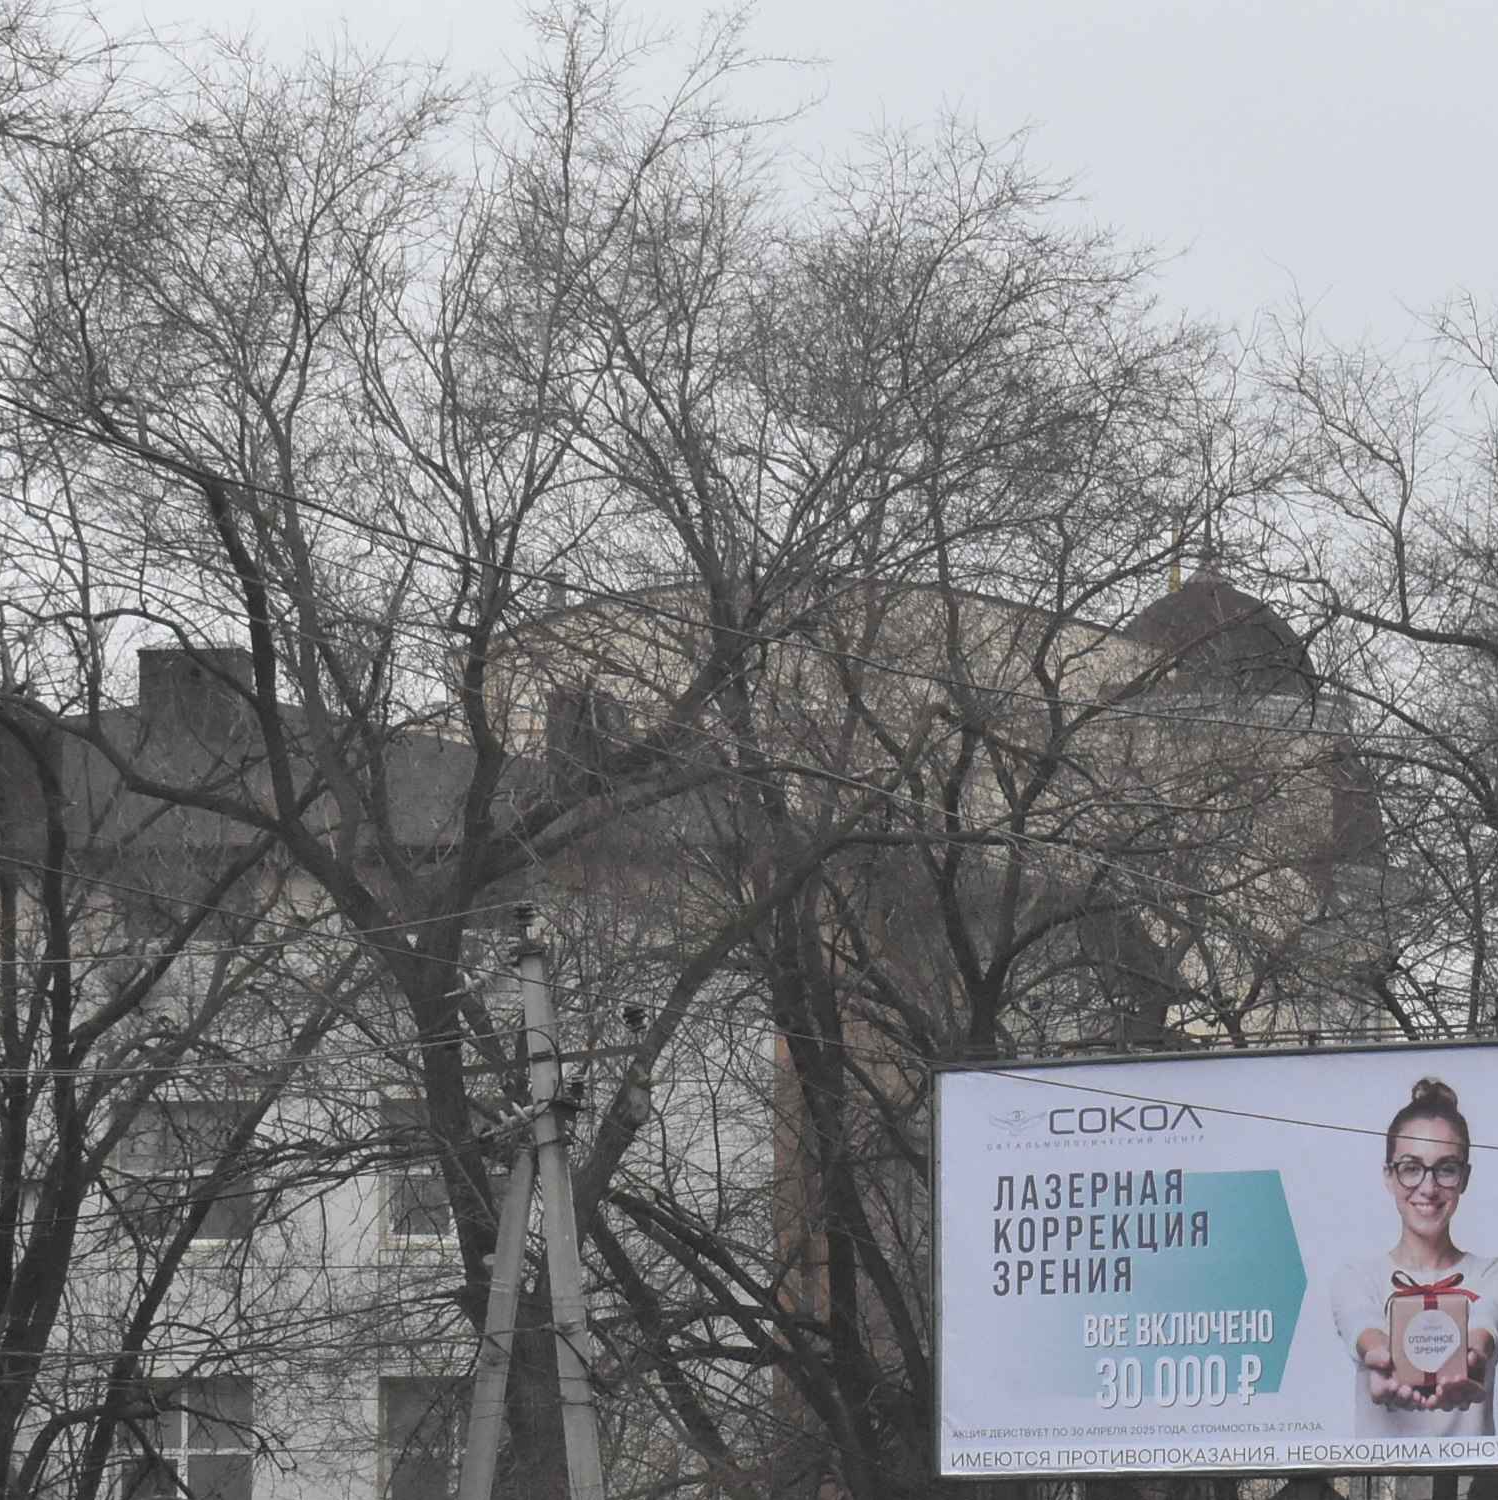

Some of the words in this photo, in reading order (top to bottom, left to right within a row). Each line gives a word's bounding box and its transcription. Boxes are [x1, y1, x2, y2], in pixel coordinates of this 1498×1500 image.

[1048, 1104, 1204, 1135] СОКОЛ
[993, 1168, 1184, 1212] ЛАЗЕРНАЯ
[993, 1211, 1209, 1254] КОРРЕКЦИЯ
[992, 1256, 1132, 1297] ЗРЕНИЯ
[1083, 1312, 1130, 1349] ВСЕ
[1135, 1308, 1275, 1346] ВКЛЮЧЕНО
[1095, 1355, 1144, 1411] 30
[1154, 1354, 1229, 1408] 000
[988, 1426, 1049, 1440] ДЕЙСТВУЕТ
[1052, 1426, 1068, 1438] ПО
[1071, 1426, 1084, 1437] 30
[1086, 1425, 1128, 1437] АПРЕЛЯ
[1191, 1422, 1260, 1434] СТОИМОСТЬ
[1263, 1422, 1276, 1433] ЗА
[1279, 1421, 1285, 1433] 2
[950, 1450, 1051, 1468] ИМЕЮТСЯ
[1057, 1446, 1280, 1467] ПРОТИВОПОКАЗАНИЯ.
[1287, 1442, 1432, 1463] НЕОБХОДИМА
